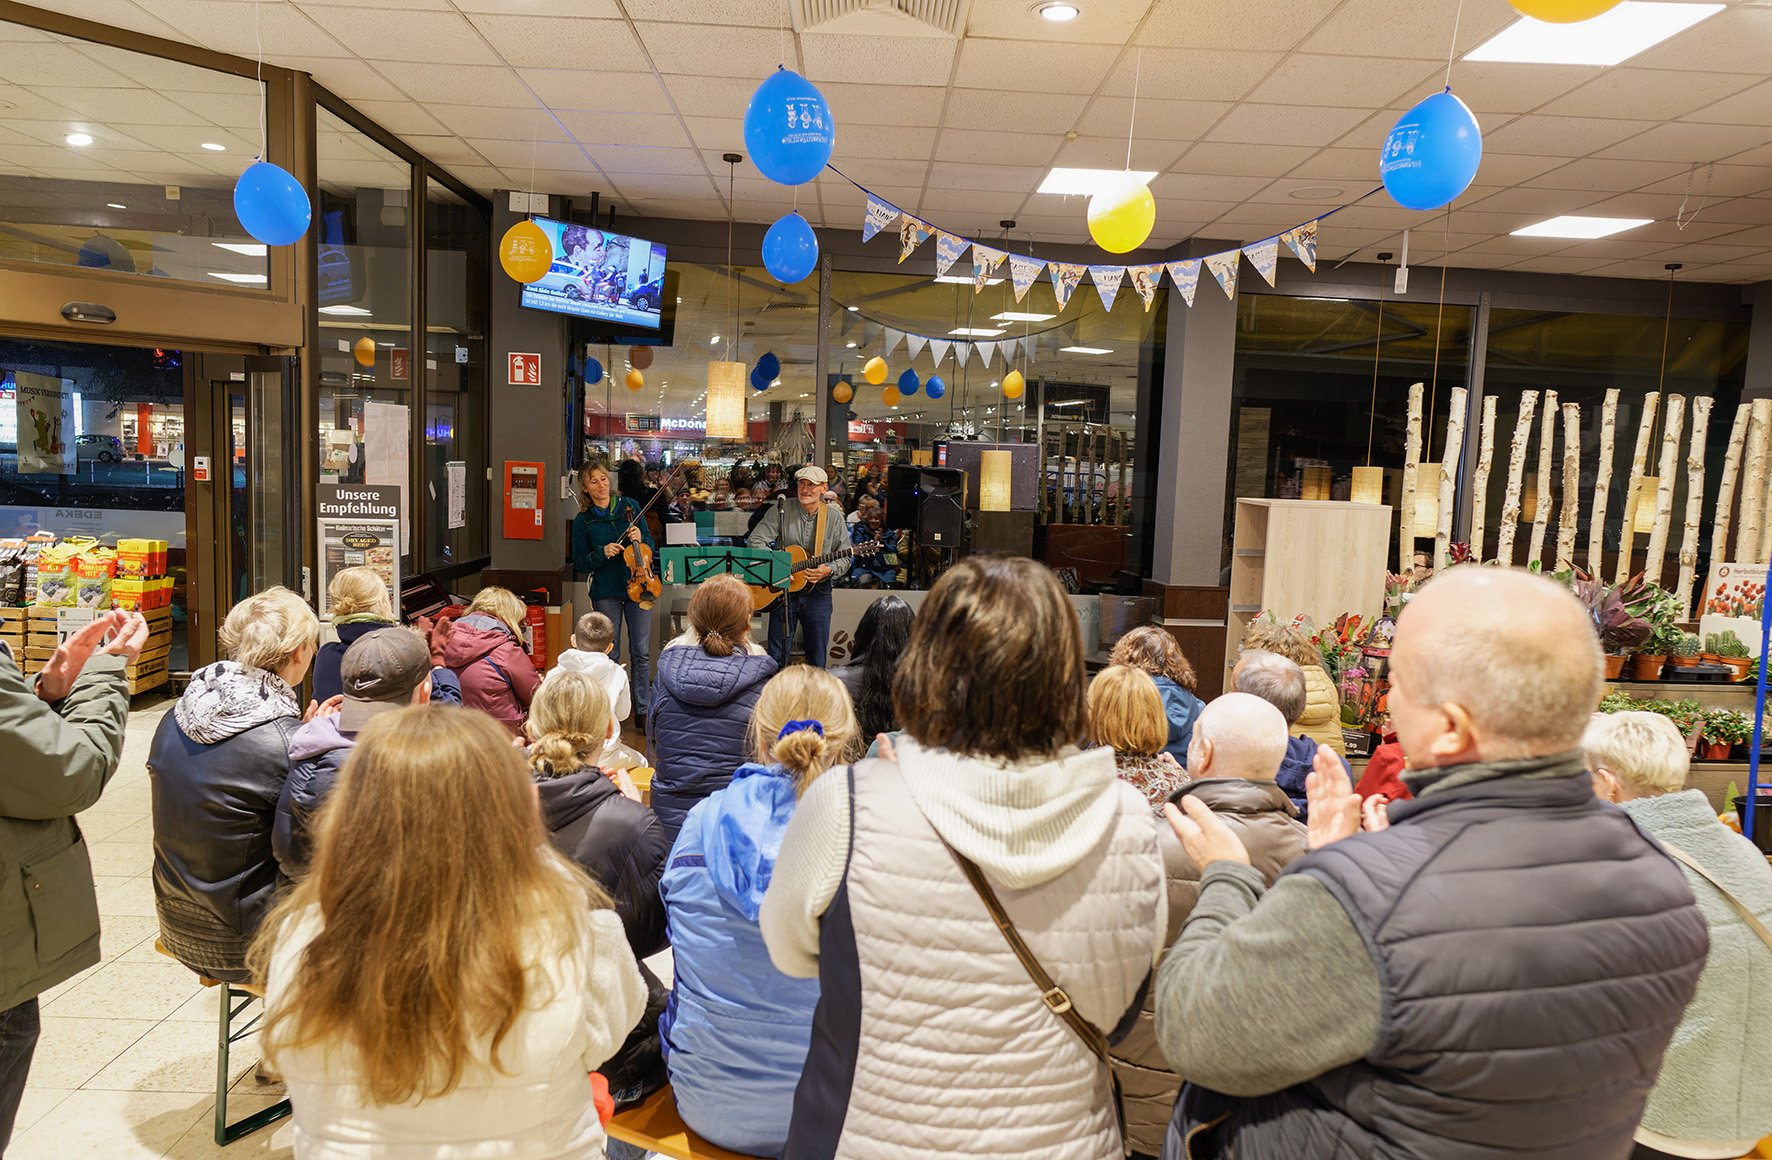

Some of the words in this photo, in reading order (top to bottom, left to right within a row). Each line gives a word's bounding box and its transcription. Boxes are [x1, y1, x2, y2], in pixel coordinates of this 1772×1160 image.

[550, 289, 568, 298] Gallery
[20, 386, 40, 396] MUSIK
[336, 489, 380, 501] Unsere
[320, 502, 397, 517] Empfehlung
